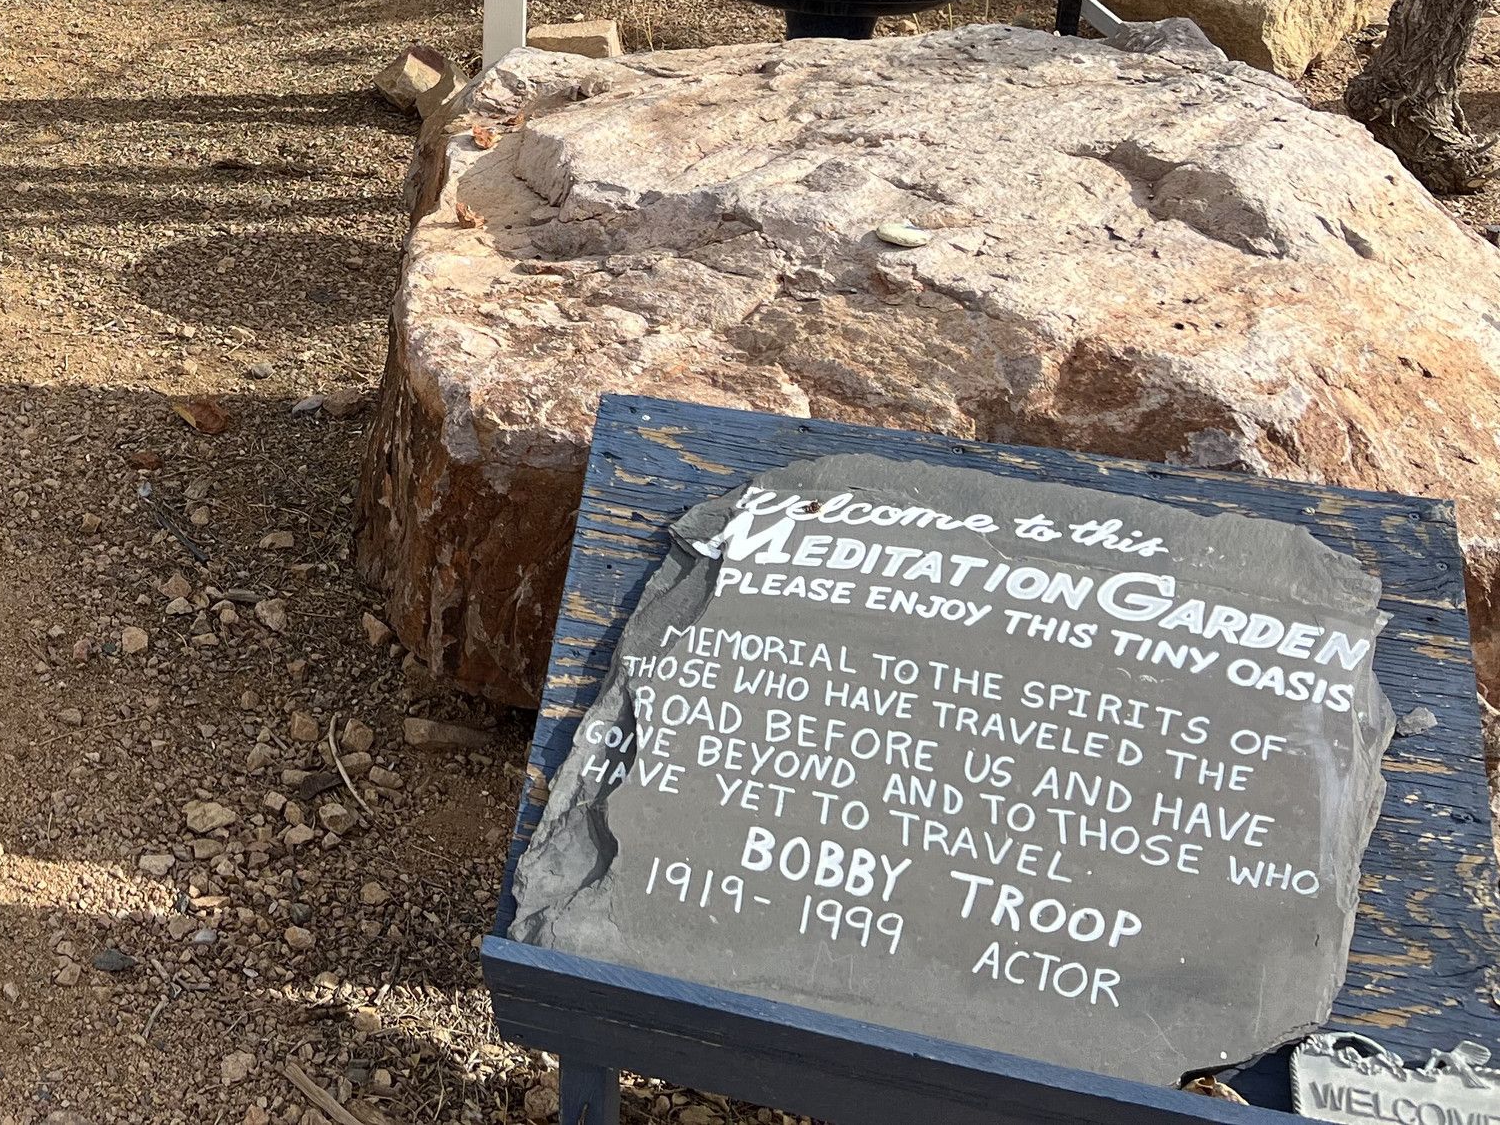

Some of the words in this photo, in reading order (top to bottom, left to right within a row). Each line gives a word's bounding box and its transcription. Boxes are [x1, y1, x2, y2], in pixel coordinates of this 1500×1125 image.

[735, 486, 1000, 534] Welcome
[1013, 513, 1062, 542] to
[1068, 517, 1170, 557] this
[693, 512, 1094, 611] MEDITATION
[1096, 571, 1370, 671] GARDEN
[714, 567, 856, 605] PLEASE
[865, 584, 993, 627] ENJOY
[1004, 608, 1099, 649] THIS
[1110, 628, 1220, 674] TINY
[1226, 658, 1356, 713] OASIS
[622, 654, 722, 690] THOSE
[733, 666, 810, 702] WHO
[824, 679, 919, 719] HAVE
[932, 700, 1144, 767] TRAVELED
[1165, 748, 1255, 792] THE
[659, 624, 857, 674] MEMORIAL
[872, 652, 919, 685] TO
[928, 660, 1004, 701] THE
[1020, 680, 1211, 745] SPIRITS
[1229, 728, 1288, 761] OF
[581, 754, 686, 795] HAVE
[715, 773, 796, 817] YET
[811, 790, 870, 831] TO
[584, 719, 677, 758] GONE
[697, 734, 857, 789] BEYOND
[882, 772, 965, 815] AND
[979, 792, 1037, 832] TO
[1046, 807, 1204, 875] THOSE
[1228, 855, 1320, 896] WHO
[633, 685, 743, 735] ROAD
[765, 708, 939, 773] BEFORE
[964, 748, 1016, 788] US
[1032, 765, 1133, 814] AND
[1151, 791, 1275, 848] HAVE
[740, 825, 912, 902] BOBBY
[950, 870, 1143, 948] TROOP
[799, 894, 905, 955] 1999
[971, 941, 1121, 1008] ACTOR
